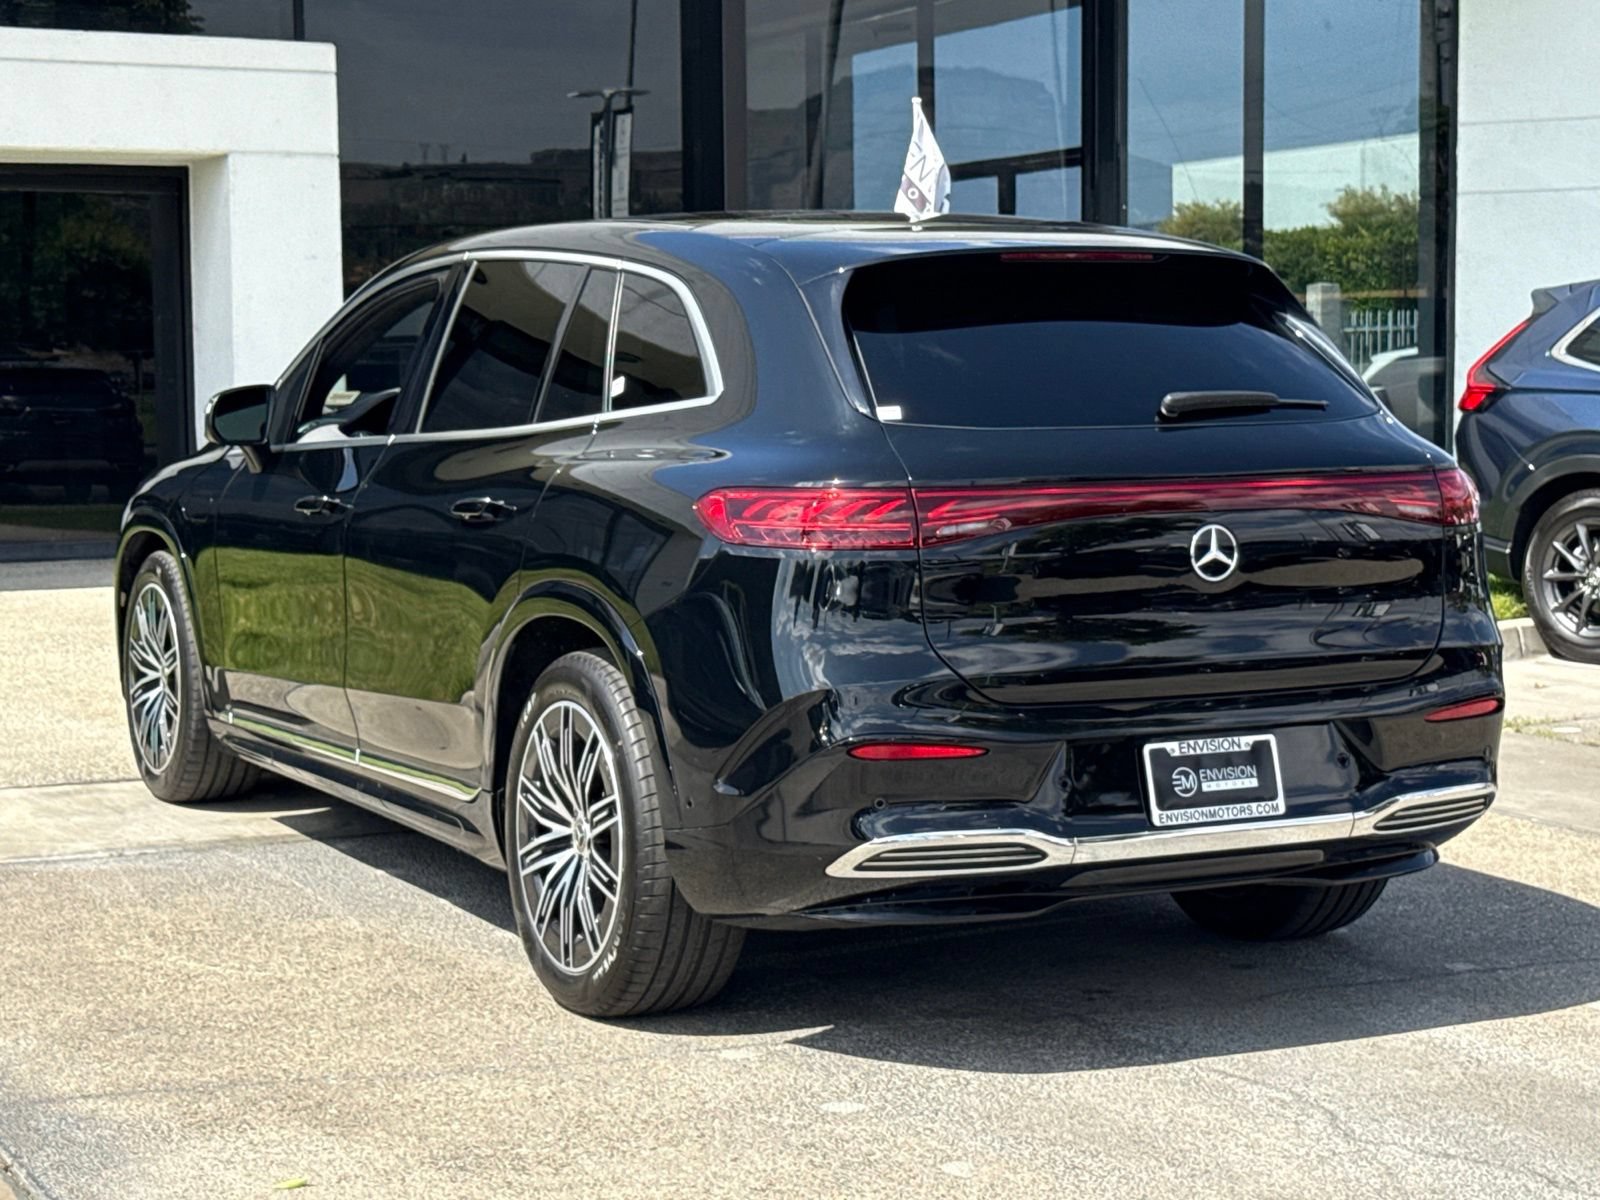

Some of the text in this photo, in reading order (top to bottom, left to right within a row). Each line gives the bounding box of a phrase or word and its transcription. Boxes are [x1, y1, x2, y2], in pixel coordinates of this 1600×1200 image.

[1178, 738, 1242, 754] ENVISION
[1199, 764, 1257, 781] ENVISION
[1158, 802, 1280, 824] ENVISIONMOTORS.COM
